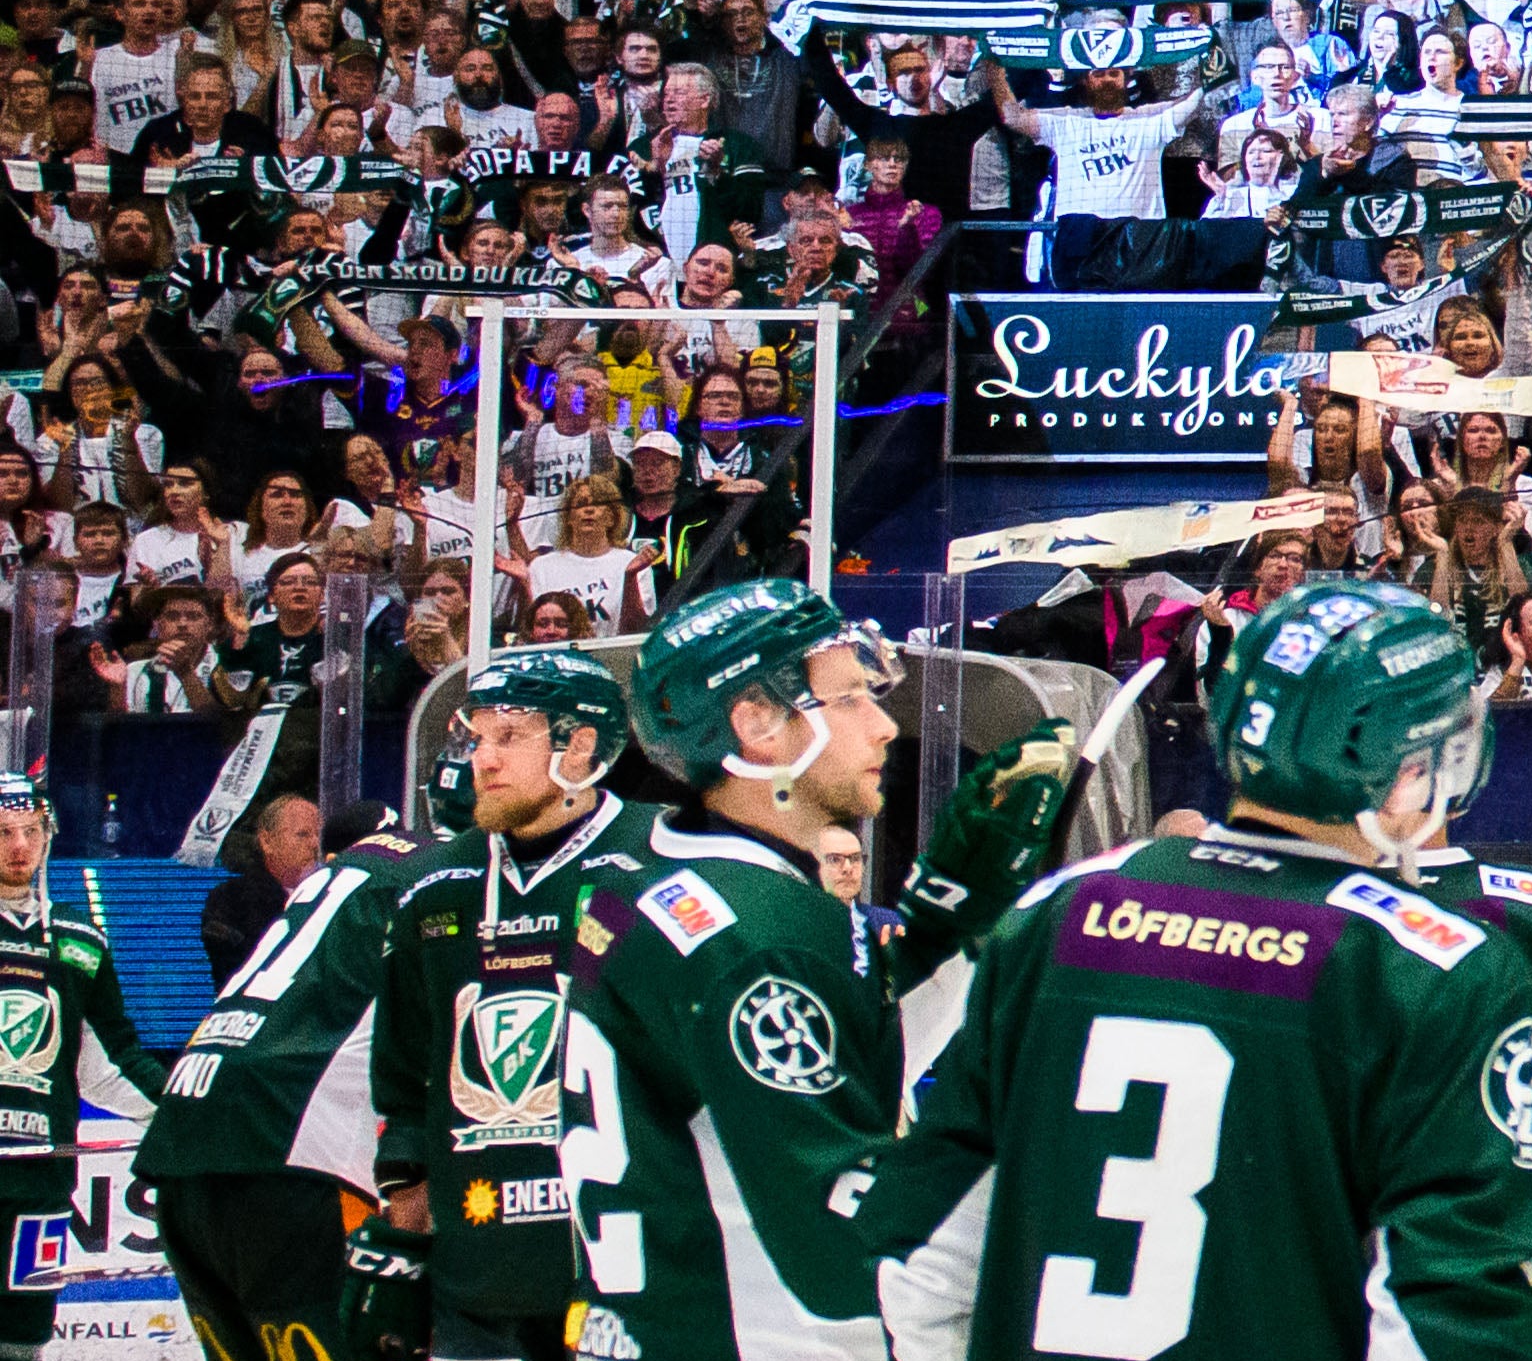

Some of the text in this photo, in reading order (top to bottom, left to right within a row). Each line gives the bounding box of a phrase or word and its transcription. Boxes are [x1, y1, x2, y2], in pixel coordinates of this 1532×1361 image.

[108, 94, 168, 125] FBK
[1081, 152, 1138, 182] FBK
[473, 266, 508, 282] DU
[431, 537, 473, 557] SOPA
[1243, 703, 1271, 746] 3
[1191, 841, 1278, 875] CCM
[1344, 876, 1459, 953] ELON
[1084, 902, 1309, 967] LÖFBERGS
